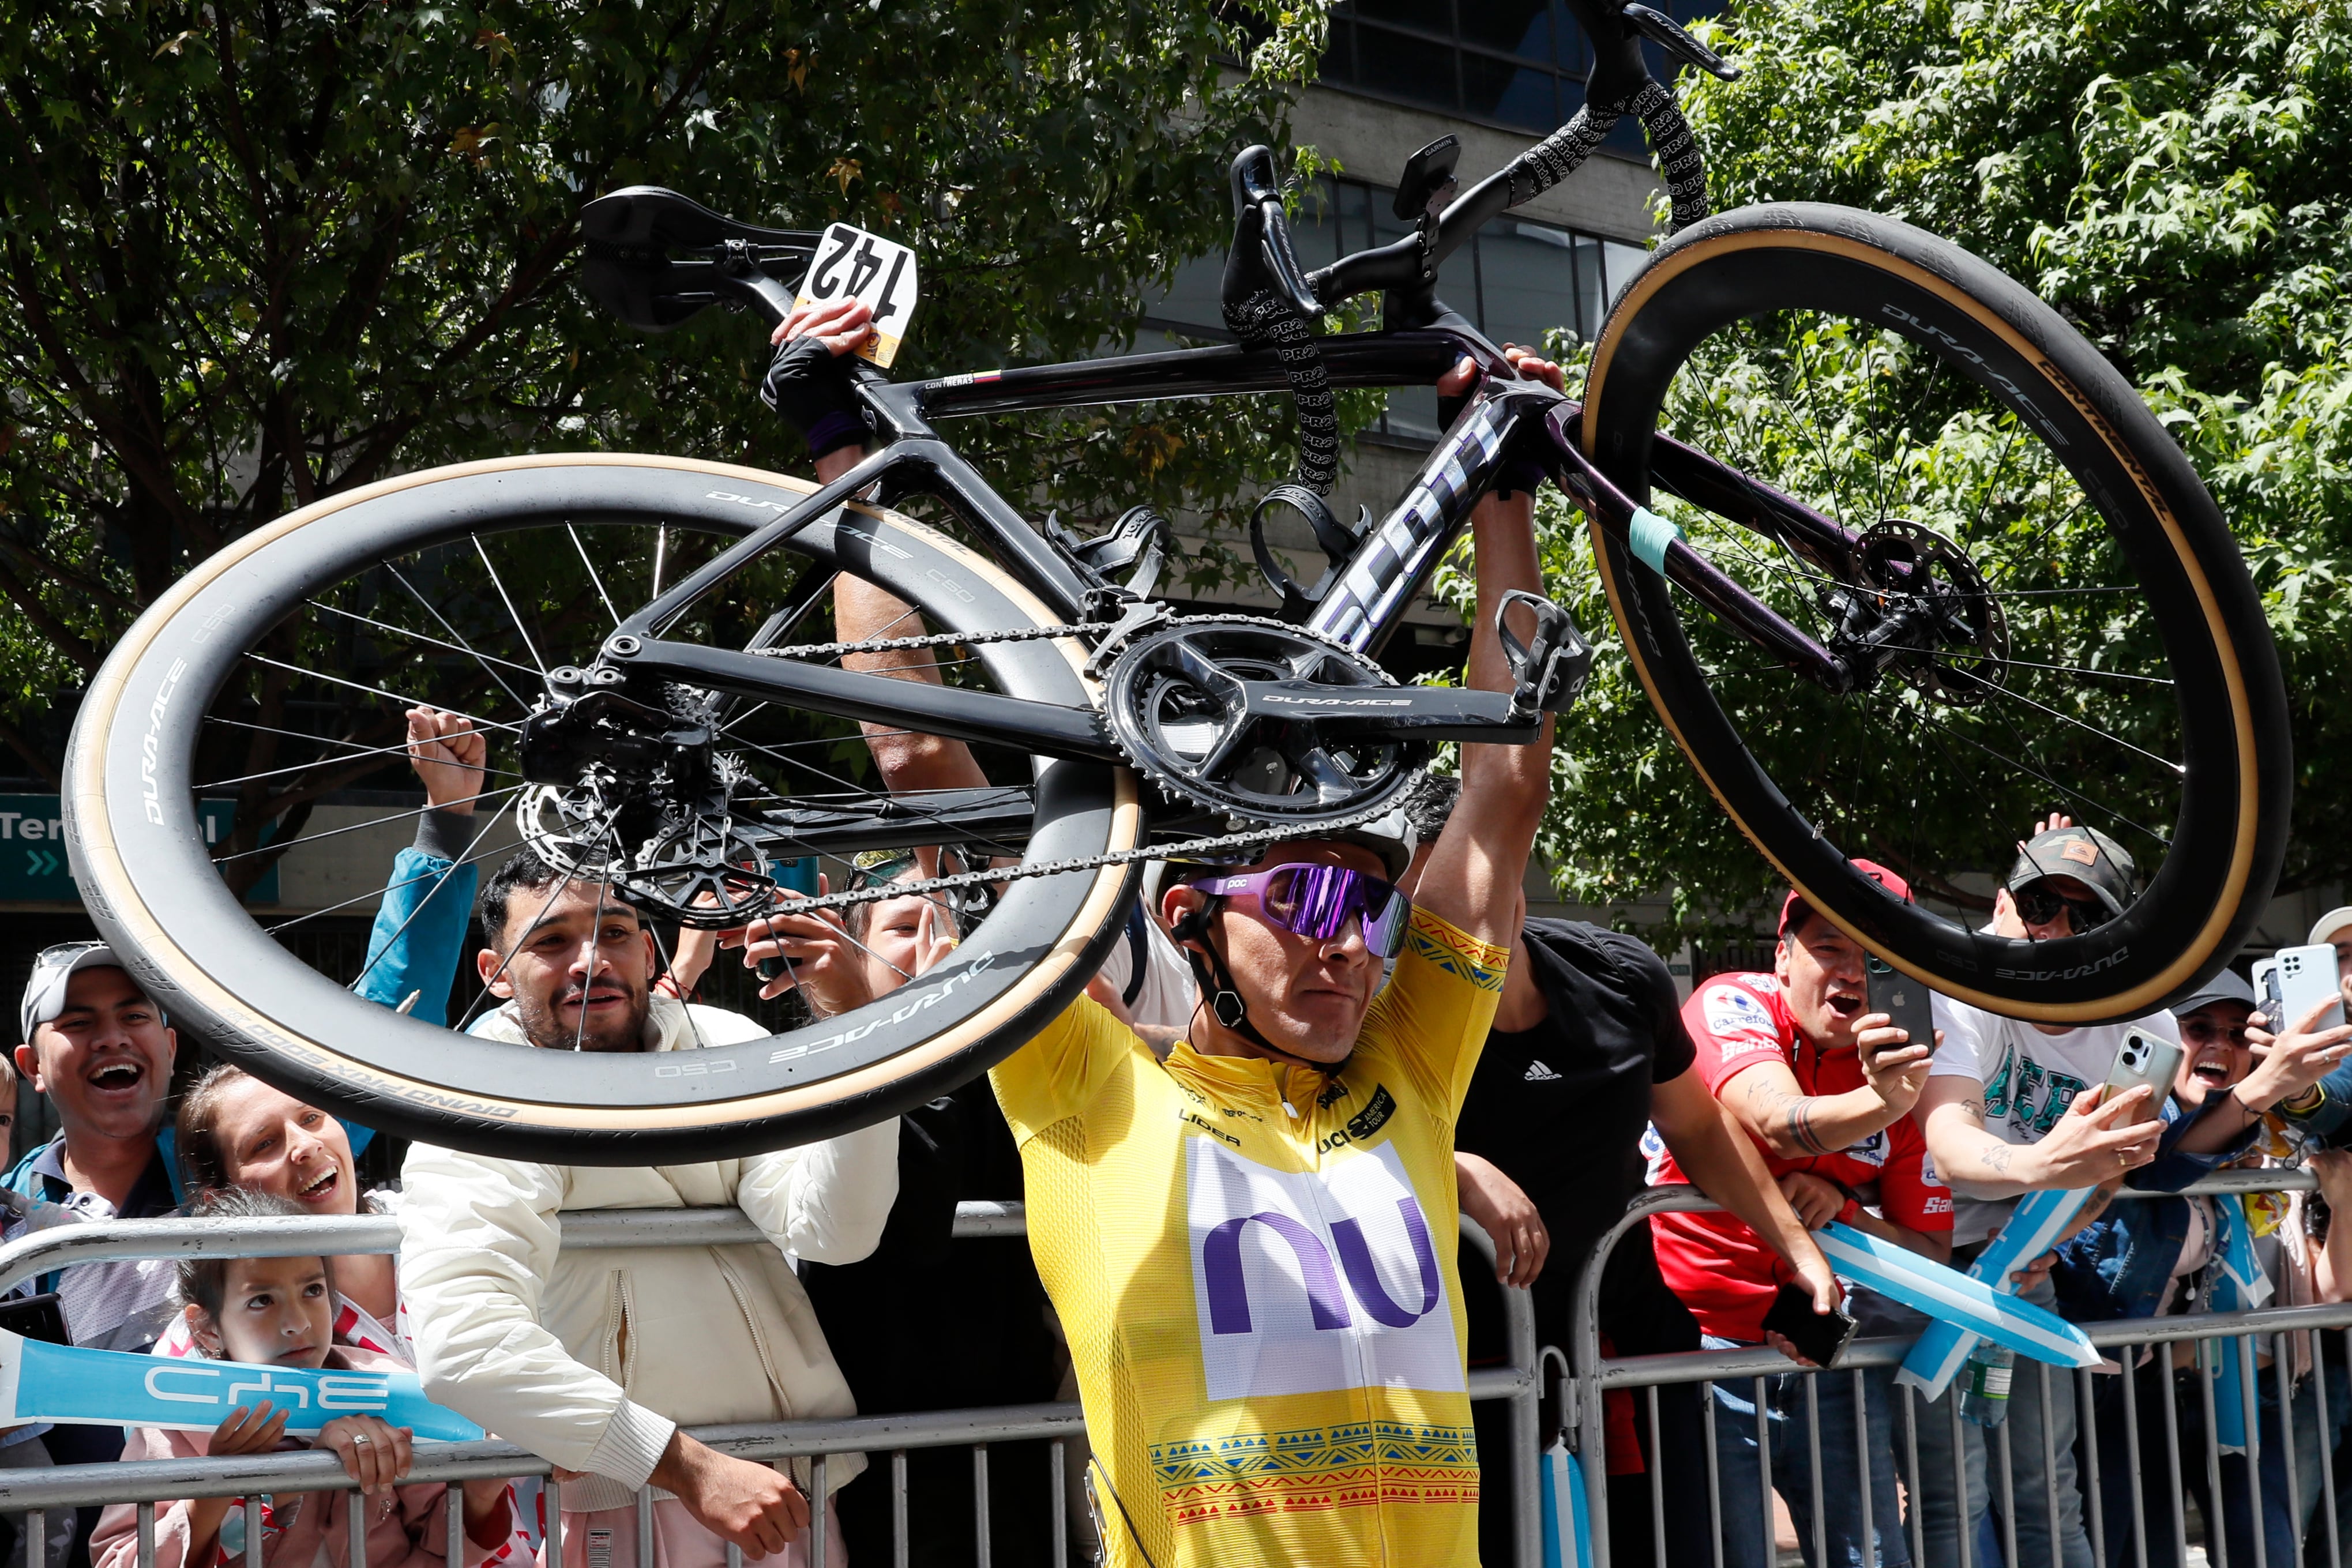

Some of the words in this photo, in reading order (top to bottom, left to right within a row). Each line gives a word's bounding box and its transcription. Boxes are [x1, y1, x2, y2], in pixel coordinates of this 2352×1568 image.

[1647, 12, 1717, 63] DURA-ACE
[1425, 138, 1452, 157] GARMIN
[1538, 145, 1563, 170] PRO
[1549, 137, 1575, 161] PRO
[1660, 132, 1690, 159] PRO
[1524, 153, 1549, 179] PRO
[1670, 149, 1699, 174] PRO
[811, 225, 908, 324] 142
[1269, 318, 1303, 338] PRO
[1282, 345, 1315, 361] PRO
[925, 378, 974, 389] CONTRERAS
[1290, 366, 1324, 382] PRO
[1881, 303, 2070, 446] DURA-ACE
[1298, 392, 1331, 406] PRO
[1301, 413, 1333, 427] PRO
[1302, 431, 1335, 448] PRO
[2038, 360, 2167, 522] CONTINENTAL
[1302, 446, 1332, 464] PRO
[705, 490, 914, 560] DUR-ACE
[1306, 400, 1501, 653] SCOTT
[191, 604, 236, 644] C50
[1262, 694, 1412, 706] DURA-ACE
[142, 656, 187, 826] DURA-ACE
[1996, 946, 2129, 981] DURA-ACE
[769, 949, 995, 1064] DURA-ACE
[1713, 1014, 1775, 1029] Carrefou
[246, 1024, 330, 1066] 5000
[326, 1064, 408, 1096] PRIX
[655, 1060, 735, 1078] C50
[403, 1089, 519, 1118] GRAND
[1364, 1092, 1387, 1121] AMERICA
[1178, 1108, 1241, 1146] LIDER
[1369, 1111, 1385, 1127] TOUR
[1317, 1129, 1351, 1155] UCI
[1203, 1197, 1440, 1334] nu
